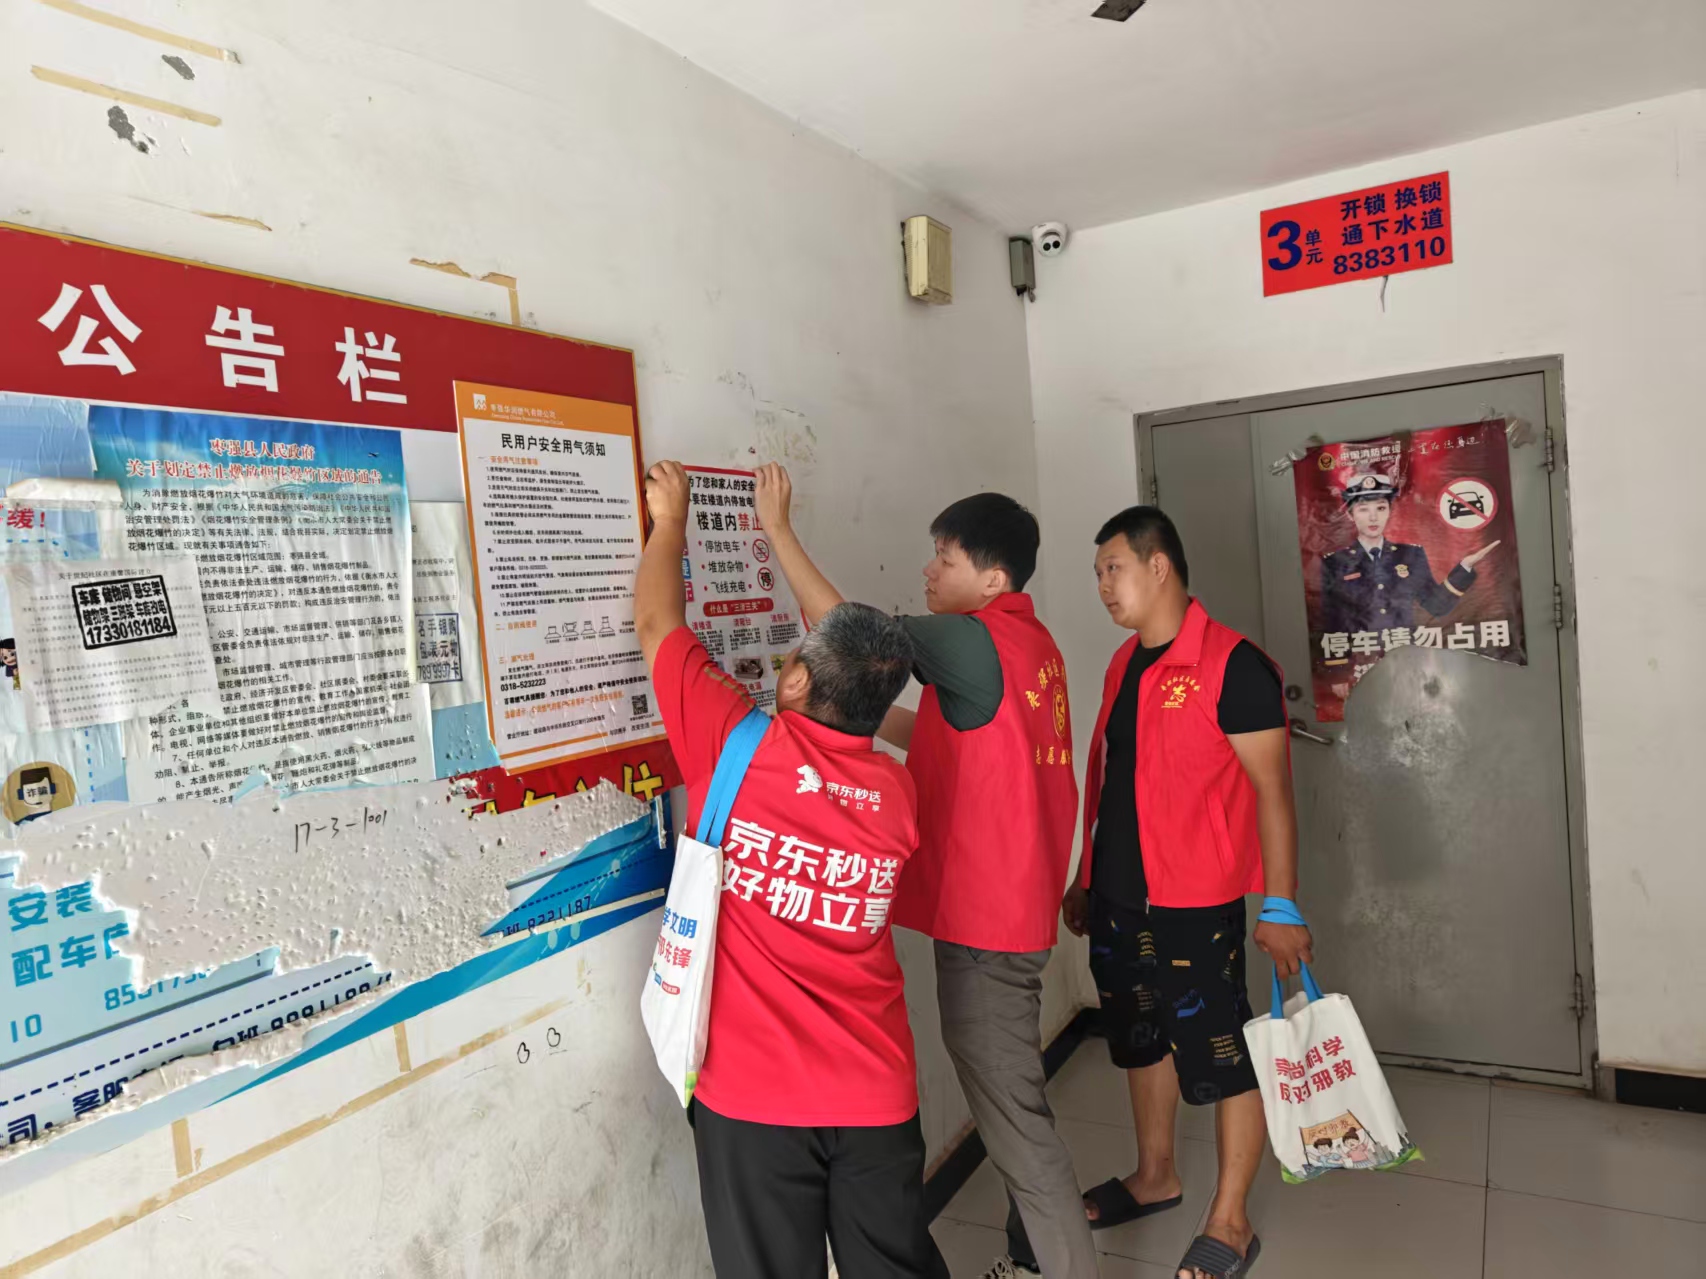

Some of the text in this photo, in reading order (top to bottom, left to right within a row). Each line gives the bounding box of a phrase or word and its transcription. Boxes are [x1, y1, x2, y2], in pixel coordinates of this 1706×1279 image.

[1340, 181, 1442, 221] 开锁 换锁
[1341, 206, 1444, 246] 通下水道
[1267, 220, 1303, 271] 3
[1305, 229, 1323, 264] 单元
[1333, 236, 1446, 275] 8383110
[37, 282, 408, 406] 公告栏
[209, 438, 315, 460] 枣强县人民政府
[500, 433, 606, 456] 民用户安全用气须知
[688, 493, 755, 509] 要在楼道内停放电
[696, 511, 764, 532] 楼道内禁止
[704, 540, 741, 553] 停放电车
[708, 561, 744, 574] 堆放杂物
[710, 580, 747, 594] 飞线充电
[86, 615, 171, 645] 17330181184
[1320, 619, 1511, 659] 停车请勿占用
[500, 678, 546, 692] 0318-5232223
[825, 781, 882, 804] 京东秒送
[294, 807, 388, 853] 17-3-1001
[723, 817, 899, 895] 京东秒送
[8, 882, 93, 932] 安装
[720, 859, 892, 935] 好物立享
[10, 1013, 43, 1043] 10
[1274, 1035, 1345, 1080] 崇尚科学
[1278, 1058, 1357, 1105] 反对邪教
